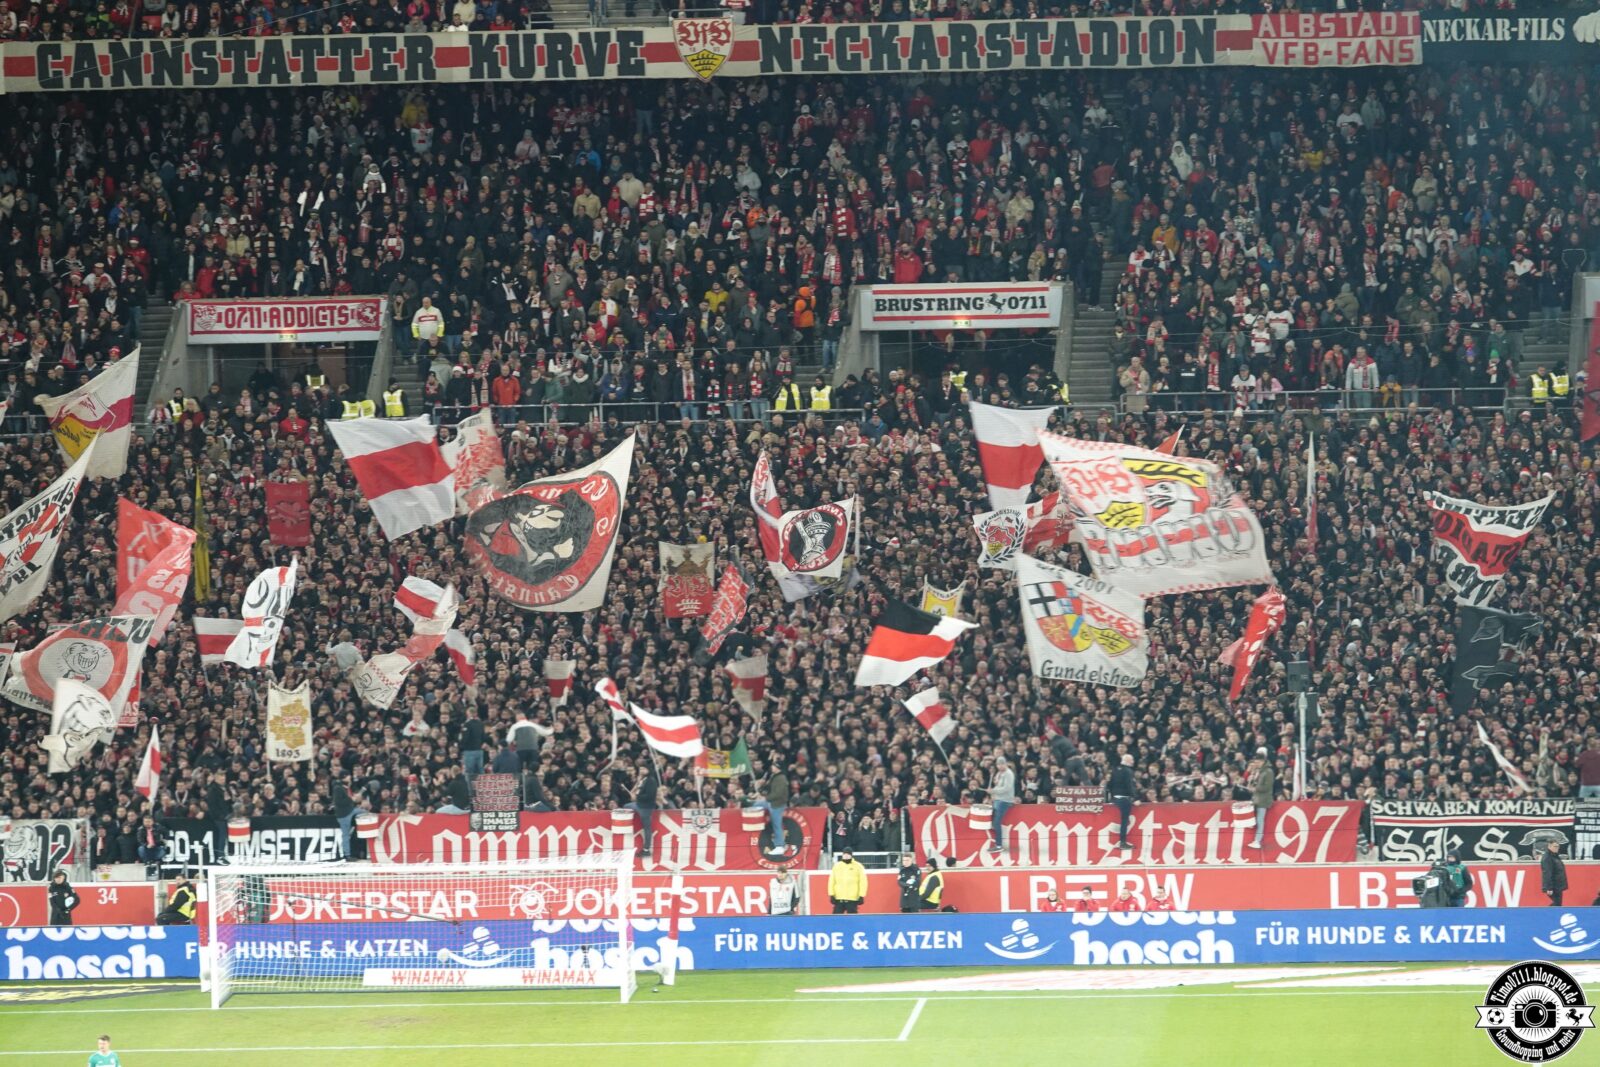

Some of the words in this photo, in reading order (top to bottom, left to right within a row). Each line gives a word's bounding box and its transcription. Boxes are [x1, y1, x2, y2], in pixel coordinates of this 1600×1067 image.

[1258, 11, 1418, 38] ALBSTADT
[1422, 17, 1566, 43] NECKAR-FILS
[37, 33, 437, 88] CANNSTATTER
[469, 30, 646, 79] KURVE
[758, 18, 1217, 75] NECKARSTADION
[1261, 40, 1415, 66] VFB-FANS
[874, 296, 984, 312] BRUSTRING
[1008, 295, 1047, 309] 0711
[1055, 787, 1086, 795] ULTRA
[1371, 800, 1480, 816] SCHWABEN
[1485, 799, 1576, 815] KOMPANIE
[1275, 804, 1349, 864] 97
[97, 888, 118, 905] 34
[268, 889, 479, 921] JOKERSTAR
[558, 885, 768, 916] JOKERSTAR
[714, 928, 759, 952] FÜR
[766, 931, 844, 951] HUNDE
[851, 932, 869, 950] &
[877, 930, 963, 949] KATZEN
[1255, 921, 1299, 945] FÜR
[1307, 926, 1386, 944] HUNDE
[1393, 926, 1411, 944] &
[1420, 925, 1506, 943] KATZEN
[186, 940, 228, 960] FR
[236, 939, 314, 959] HUNDE
[320, 940, 338, 957] &
[345, 939, 428, 958] KATZEN
[1069, 929, 1235, 965] bosch
[4, 944, 166, 980] bosch
[391, 970, 467, 985] WINAMAX
[521, 969, 597, 985] WINAMAX
